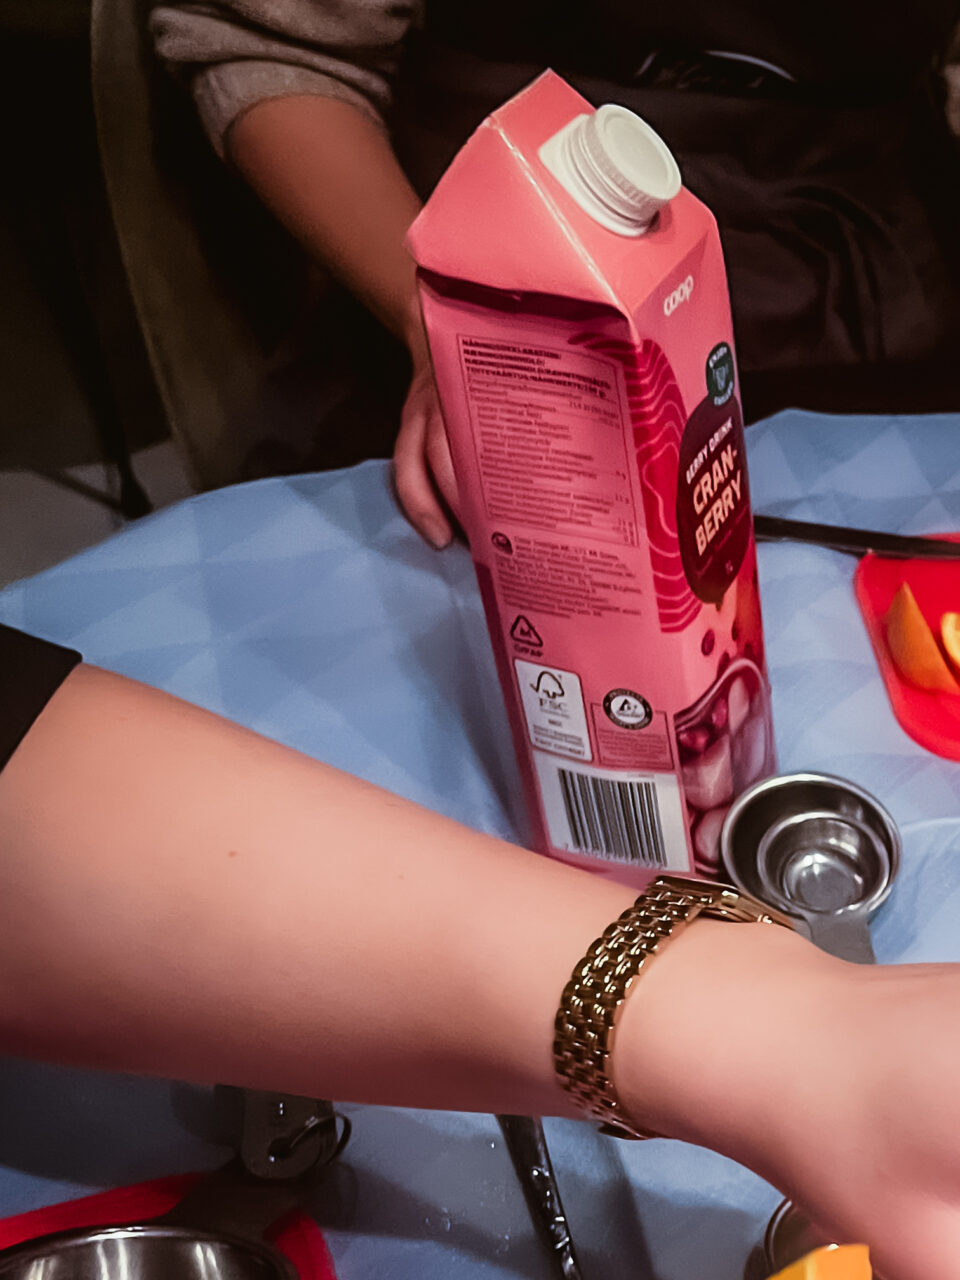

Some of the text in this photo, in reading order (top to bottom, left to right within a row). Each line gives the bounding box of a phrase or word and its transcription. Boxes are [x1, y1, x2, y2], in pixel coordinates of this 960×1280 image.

[663, 274, 694, 317] coop
[686, 416, 732, 485] BERRY DRINK
[693, 444, 737, 515] CRAN-
[695, 469, 741, 556] BERRY
